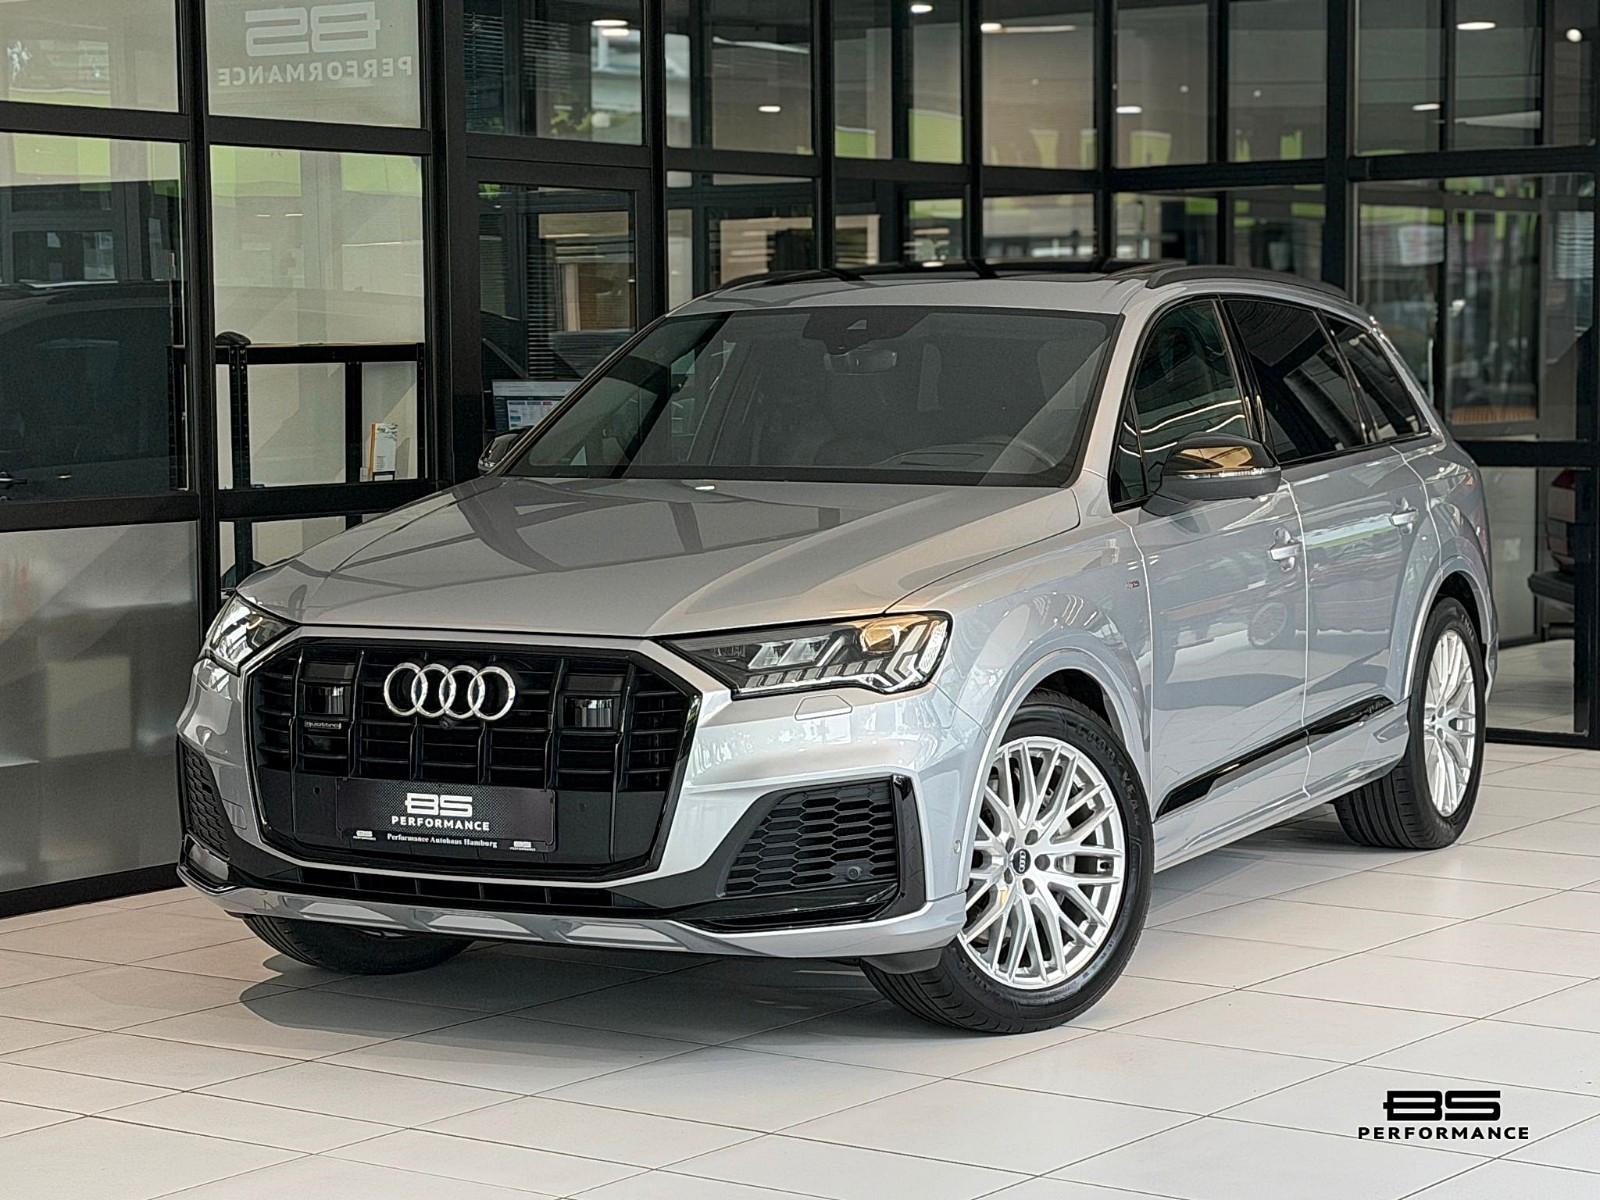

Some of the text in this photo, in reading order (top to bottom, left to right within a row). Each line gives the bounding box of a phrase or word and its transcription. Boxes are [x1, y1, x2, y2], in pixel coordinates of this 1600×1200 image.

[405, 792, 473, 817] BS
[391, 815, 490, 831] PERFORMANCE
[387, 832, 429, 843] Performance
[430, 836, 462, 845] Autohaus
[463, 838, 498, 849] Hamburg
